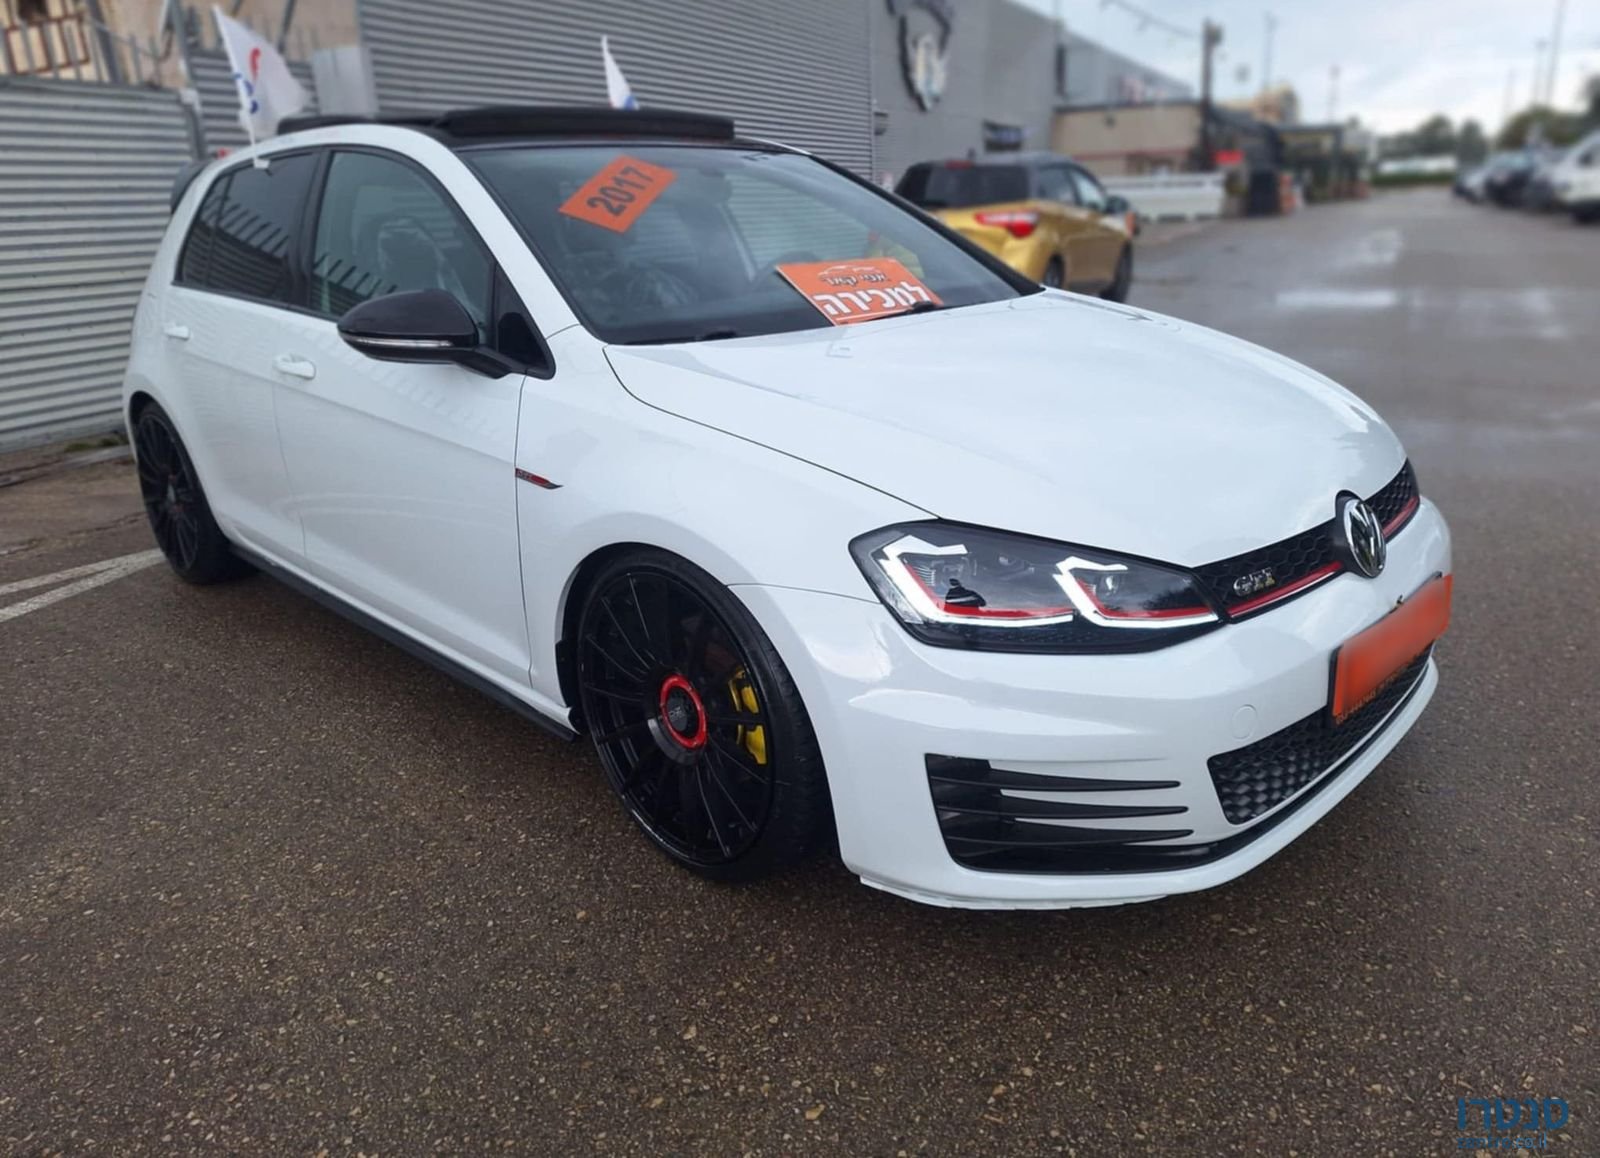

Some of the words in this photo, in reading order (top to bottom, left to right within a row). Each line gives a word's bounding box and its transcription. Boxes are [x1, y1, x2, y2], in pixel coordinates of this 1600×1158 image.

[586, 166, 653, 216] 2017
[814, 281, 931, 315] למכירה
[1233, 567, 1275, 596] GTI
